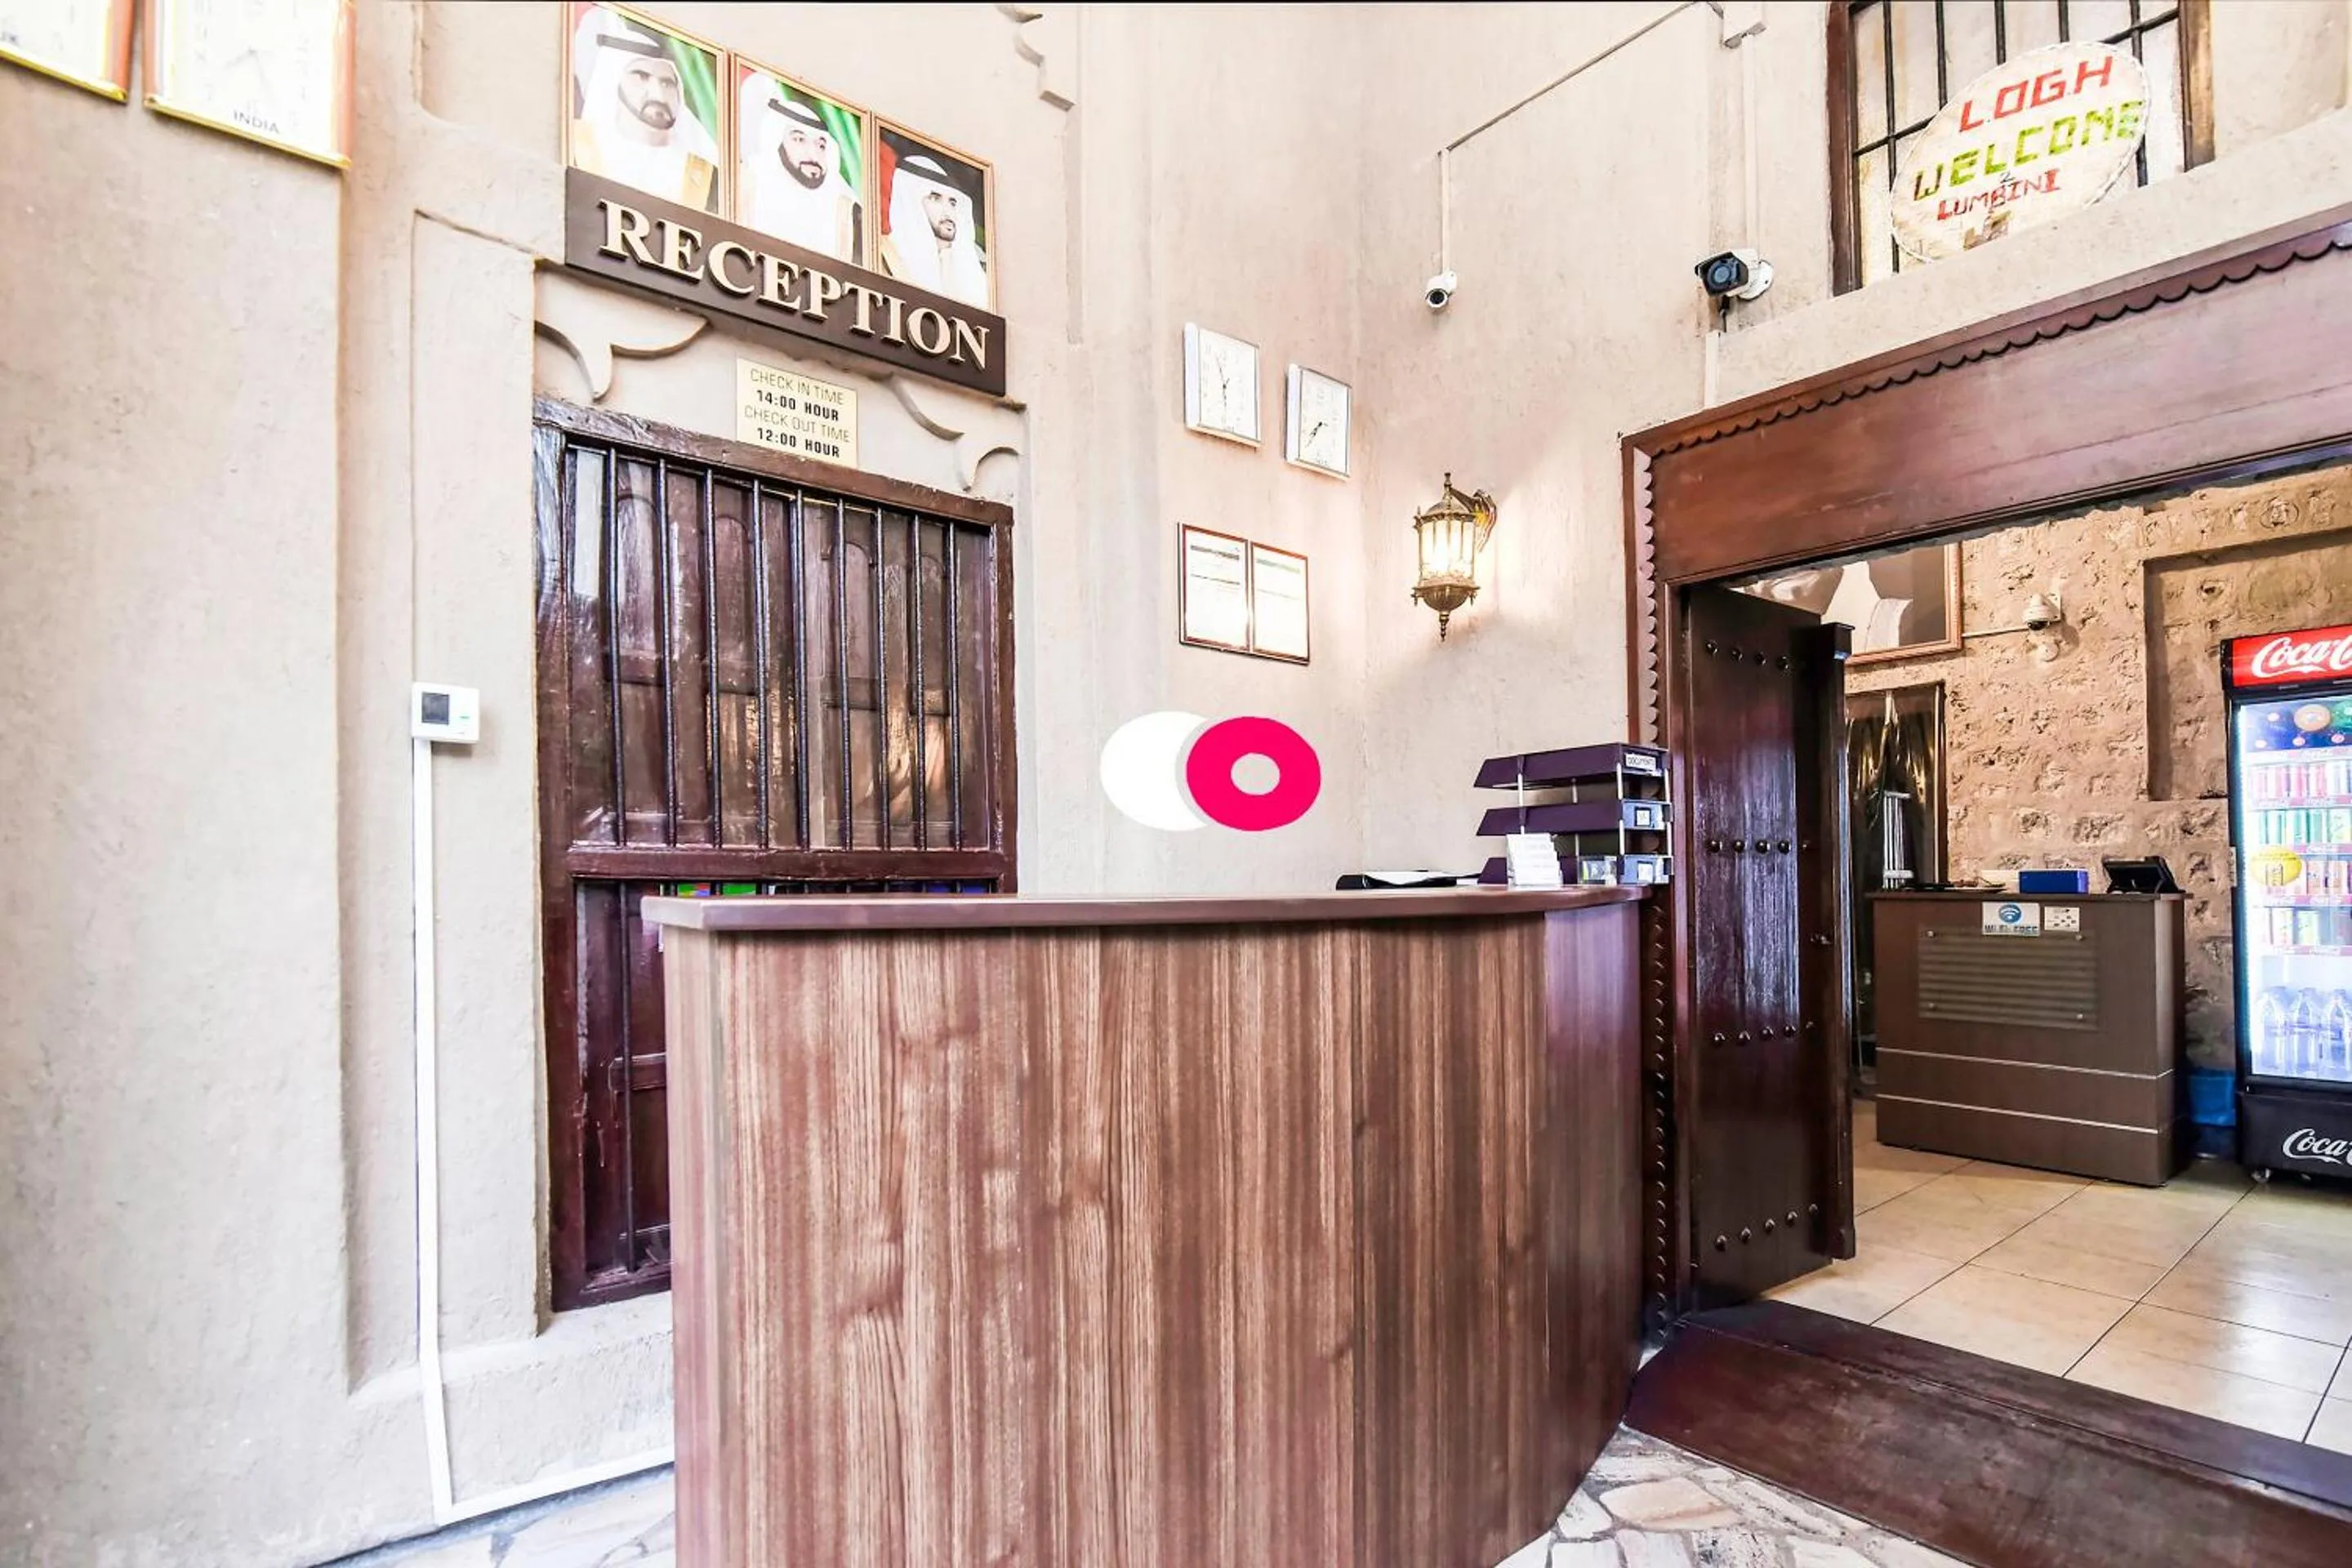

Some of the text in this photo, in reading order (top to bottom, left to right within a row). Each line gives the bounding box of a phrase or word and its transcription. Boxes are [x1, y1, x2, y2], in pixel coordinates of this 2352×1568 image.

[234, 109, 280, 134] INDIA
[1913, 100, 2143, 202] WELCOME
[1936, 167, 2062, 220] LUMBINI
[598, 198, 991, 371] RECEPTION
[750, 368, 844, 406] CHECK IN TIME
[756, 390, 840, 422] 14:00 HOUR
[744, 405, 851, 443] CHECK OUT TIME
[756, 427, 840, 458] 12:00 HOUR
